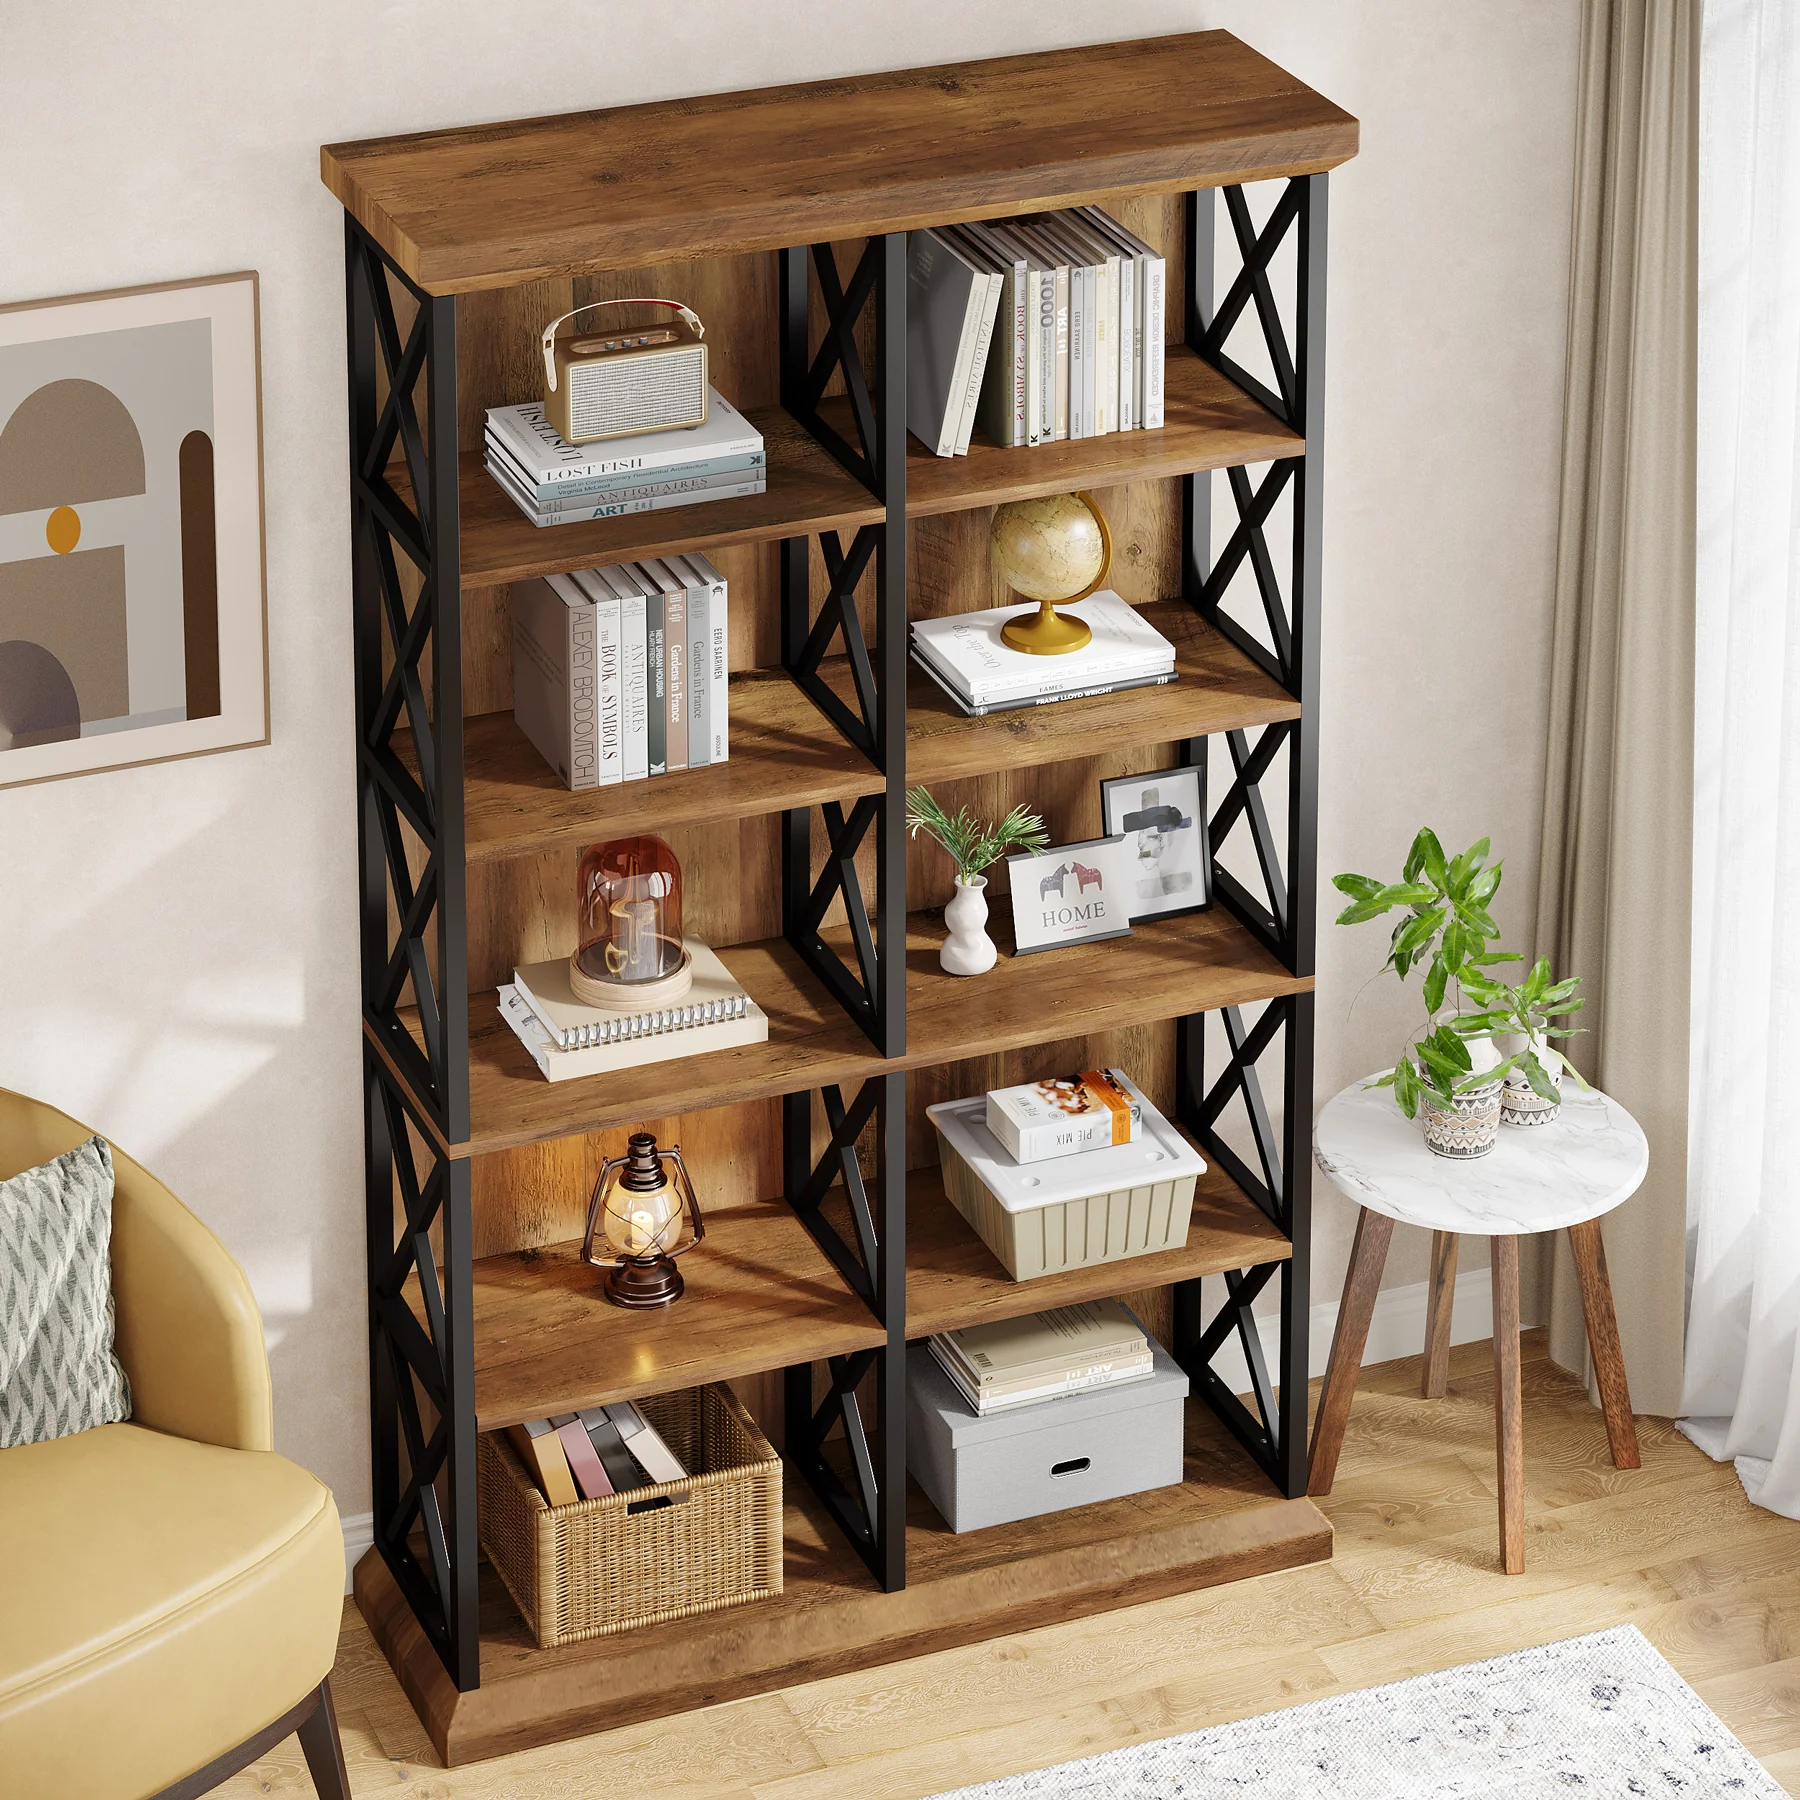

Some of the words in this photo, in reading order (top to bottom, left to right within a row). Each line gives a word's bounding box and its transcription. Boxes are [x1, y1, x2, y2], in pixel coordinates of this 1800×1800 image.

[516, 406, 554, 432] FISH
[540, 431, 584, 462] LOST
[547, 464, 596, 482] LOST
[601, 458, 643, 473] FISH
[557, 482, 576, 490] Detail
[585, 474, 632, 487] Contemporary
[633, 467, 669, 479] Residential
[670, 462, 709, 474] Architecture
[558, 487, 583, 496] Virginia
[597, 477, 709, 501] ANTIQUAIRES
[592, 503, 628, 518] ART
[572, 611, 593, 671] ALEXEY
[600, 630, 609, 643] THE
[655, 629, 664, 645] NEW
[714, 628, 723, 645] EERO
[952, 624, 971, 640] Top
[656, 645, 664, 667] URBAN
[966, 639, 985, 653] the
[601, 644, 617, 682] BOOK
[671, 644, 682, 680] Gardens
[693, 641, 704, 677] Gardens
[714, 646, 723, 680] SAARINEN
[978, 650, 1001, 669] Over
[601, 685, 609, 694] OF
[629, 643, 645, 733] ANTIQUAIRES
[656, 668, 664, 698] HOUSING
[671, 682, 682, 692] in
[693, 678, 703, 688] in
[1039, 683, 1064, 693] EAMES
[671, 693, 682, 723] France
[693, 689, 704, 719] France
[1036, 696, 1059, 706] FRANK
[1060, 692, 1083, 702] LLOYD
[1084, 687, 1114, 697] WRIGHT
[573, 676, 595, 779] BRODOVITCH
[602, 695, 618, 760] SYMBOLS
[1042, 901, 1106, 928] HOME
[1056, 1132, 1073, 1146] MIX
[1078, 1128, 1093, 1142] PIE
[1084, 1363, 1113, 1376] ART
